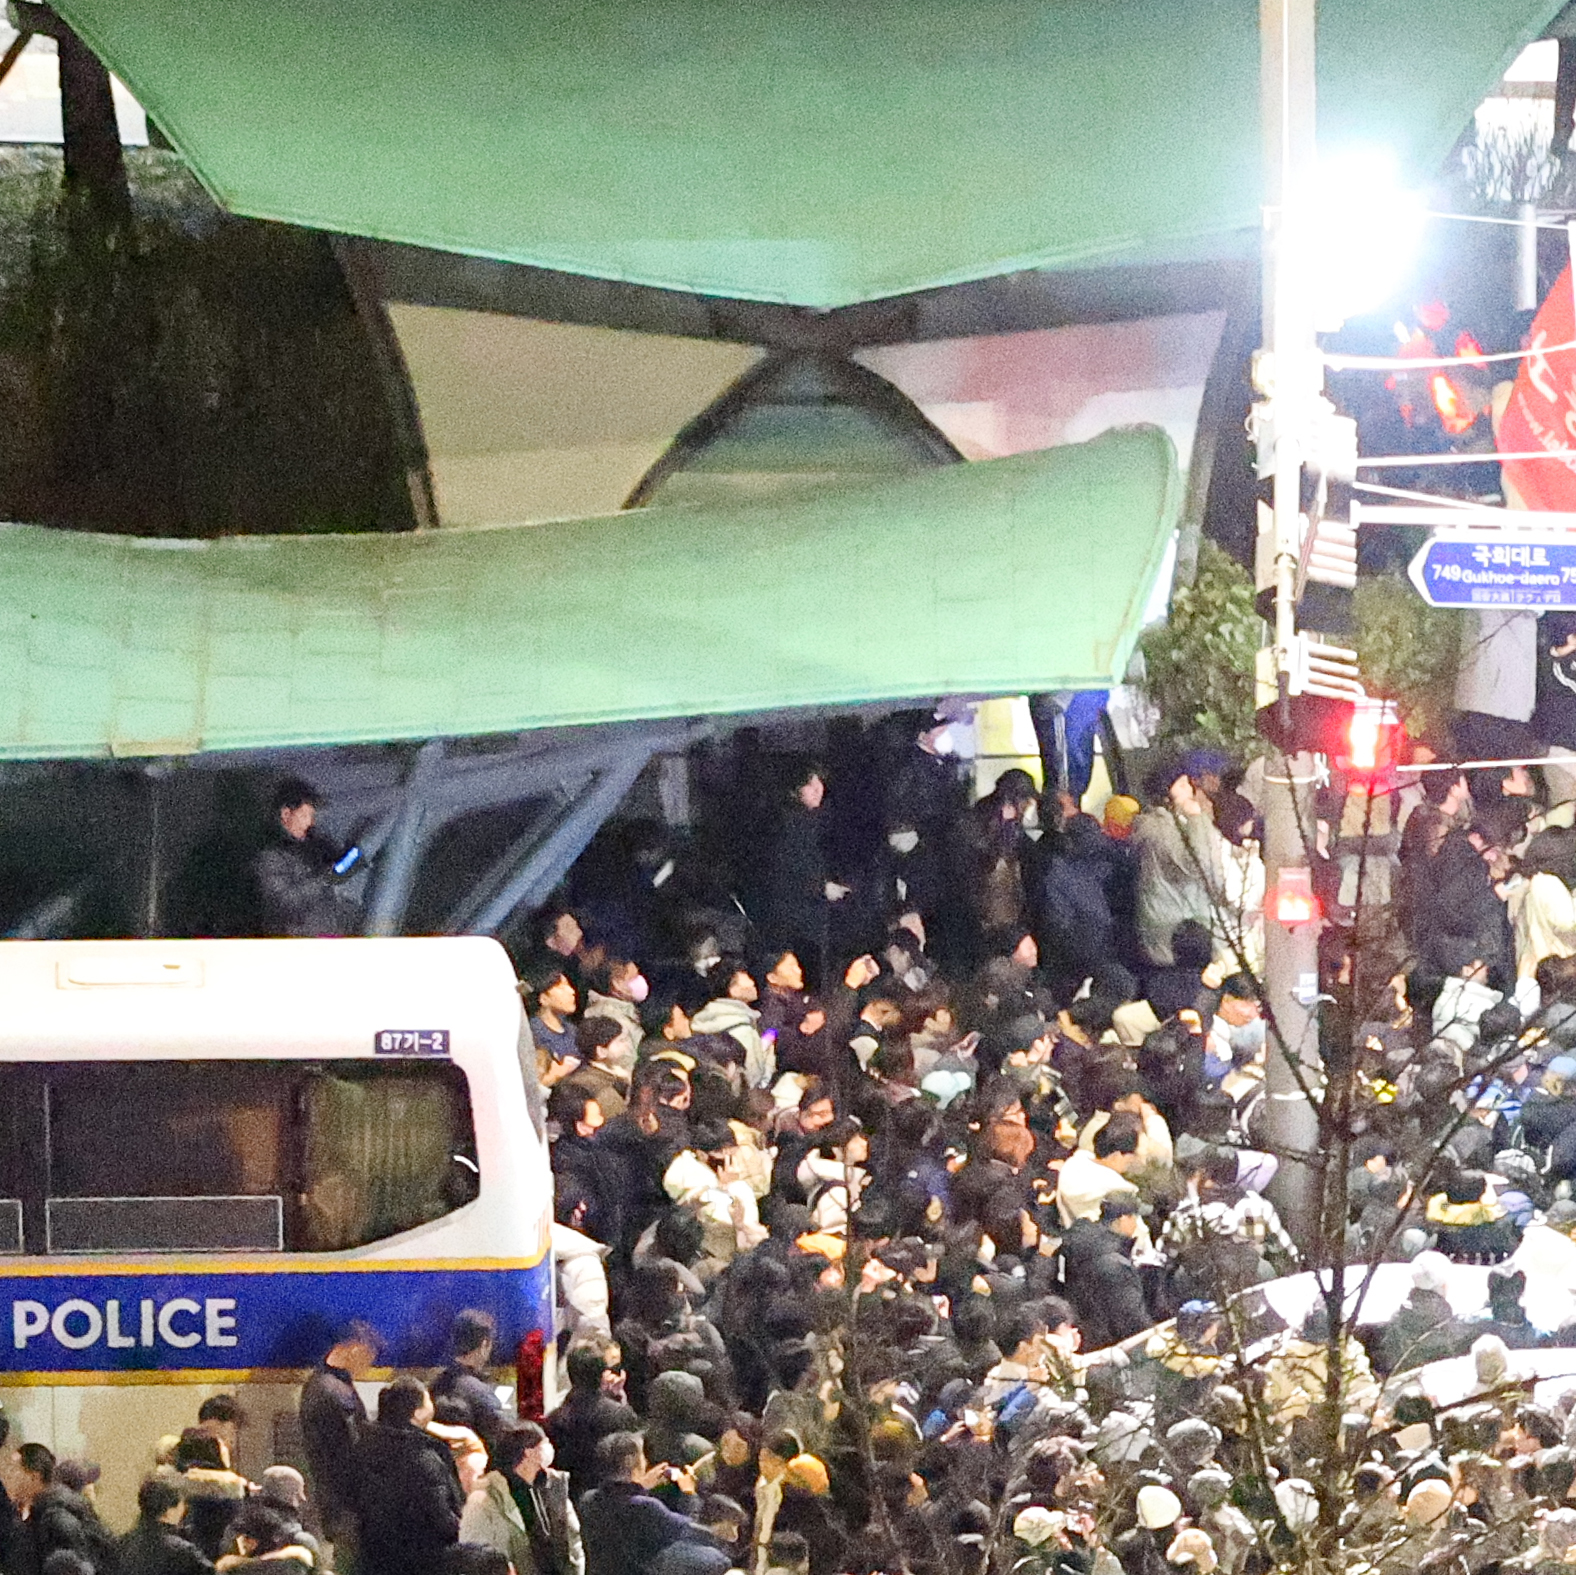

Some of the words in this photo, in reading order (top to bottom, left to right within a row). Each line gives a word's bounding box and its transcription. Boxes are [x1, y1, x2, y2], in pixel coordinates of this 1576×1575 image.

[1471, 545, 1550, 567] 국회대로
[1432, 564, 1461, 581] 749
[1462, 570, 1560, 585] Gukhoe-daero
[380, 1032, 443, 1052] 87기-2
[12, 1298, 239, 1349] POLICE
